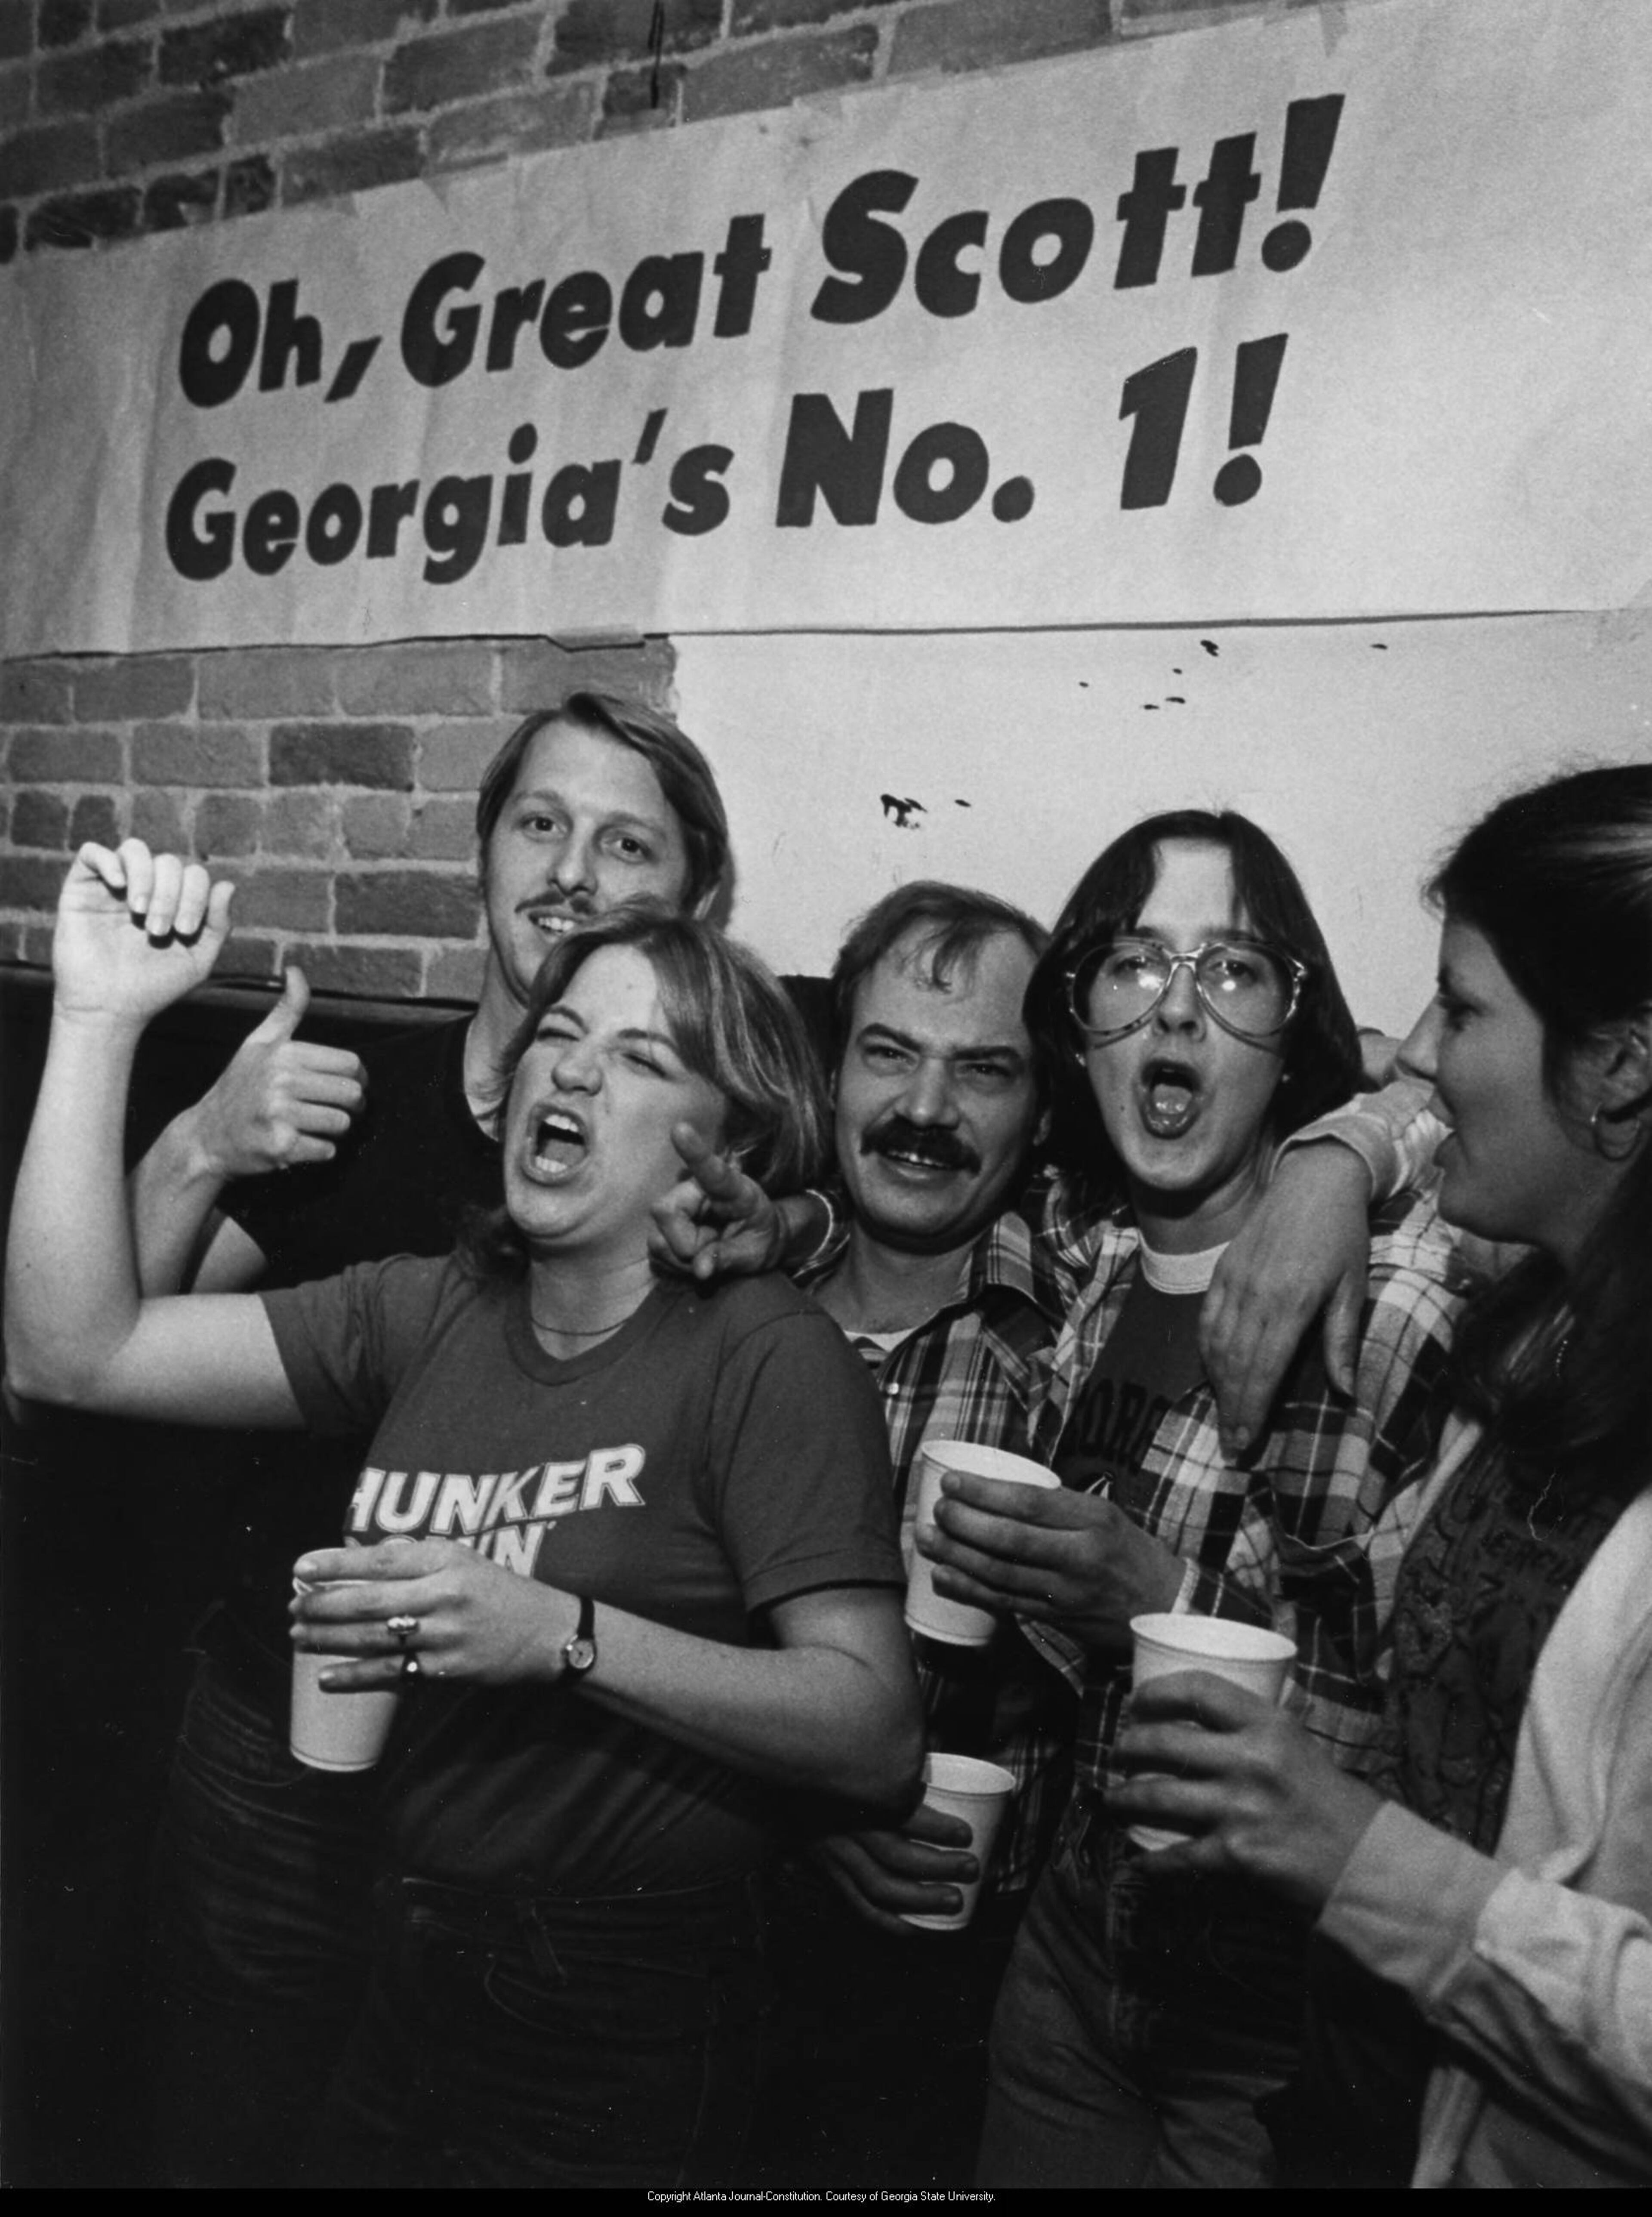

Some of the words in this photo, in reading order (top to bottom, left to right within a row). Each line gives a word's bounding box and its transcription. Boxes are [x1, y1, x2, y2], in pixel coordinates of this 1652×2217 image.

[178, 277, 382, 409] Oh,
[400, 214, 772, 388] Great
[811, 94, 1345, 324] Scott!
[165, 408, 734, 584] Georgia's
[776, 389, 1033, 527] No.
[1119, 333, 1288, 509] 1!
